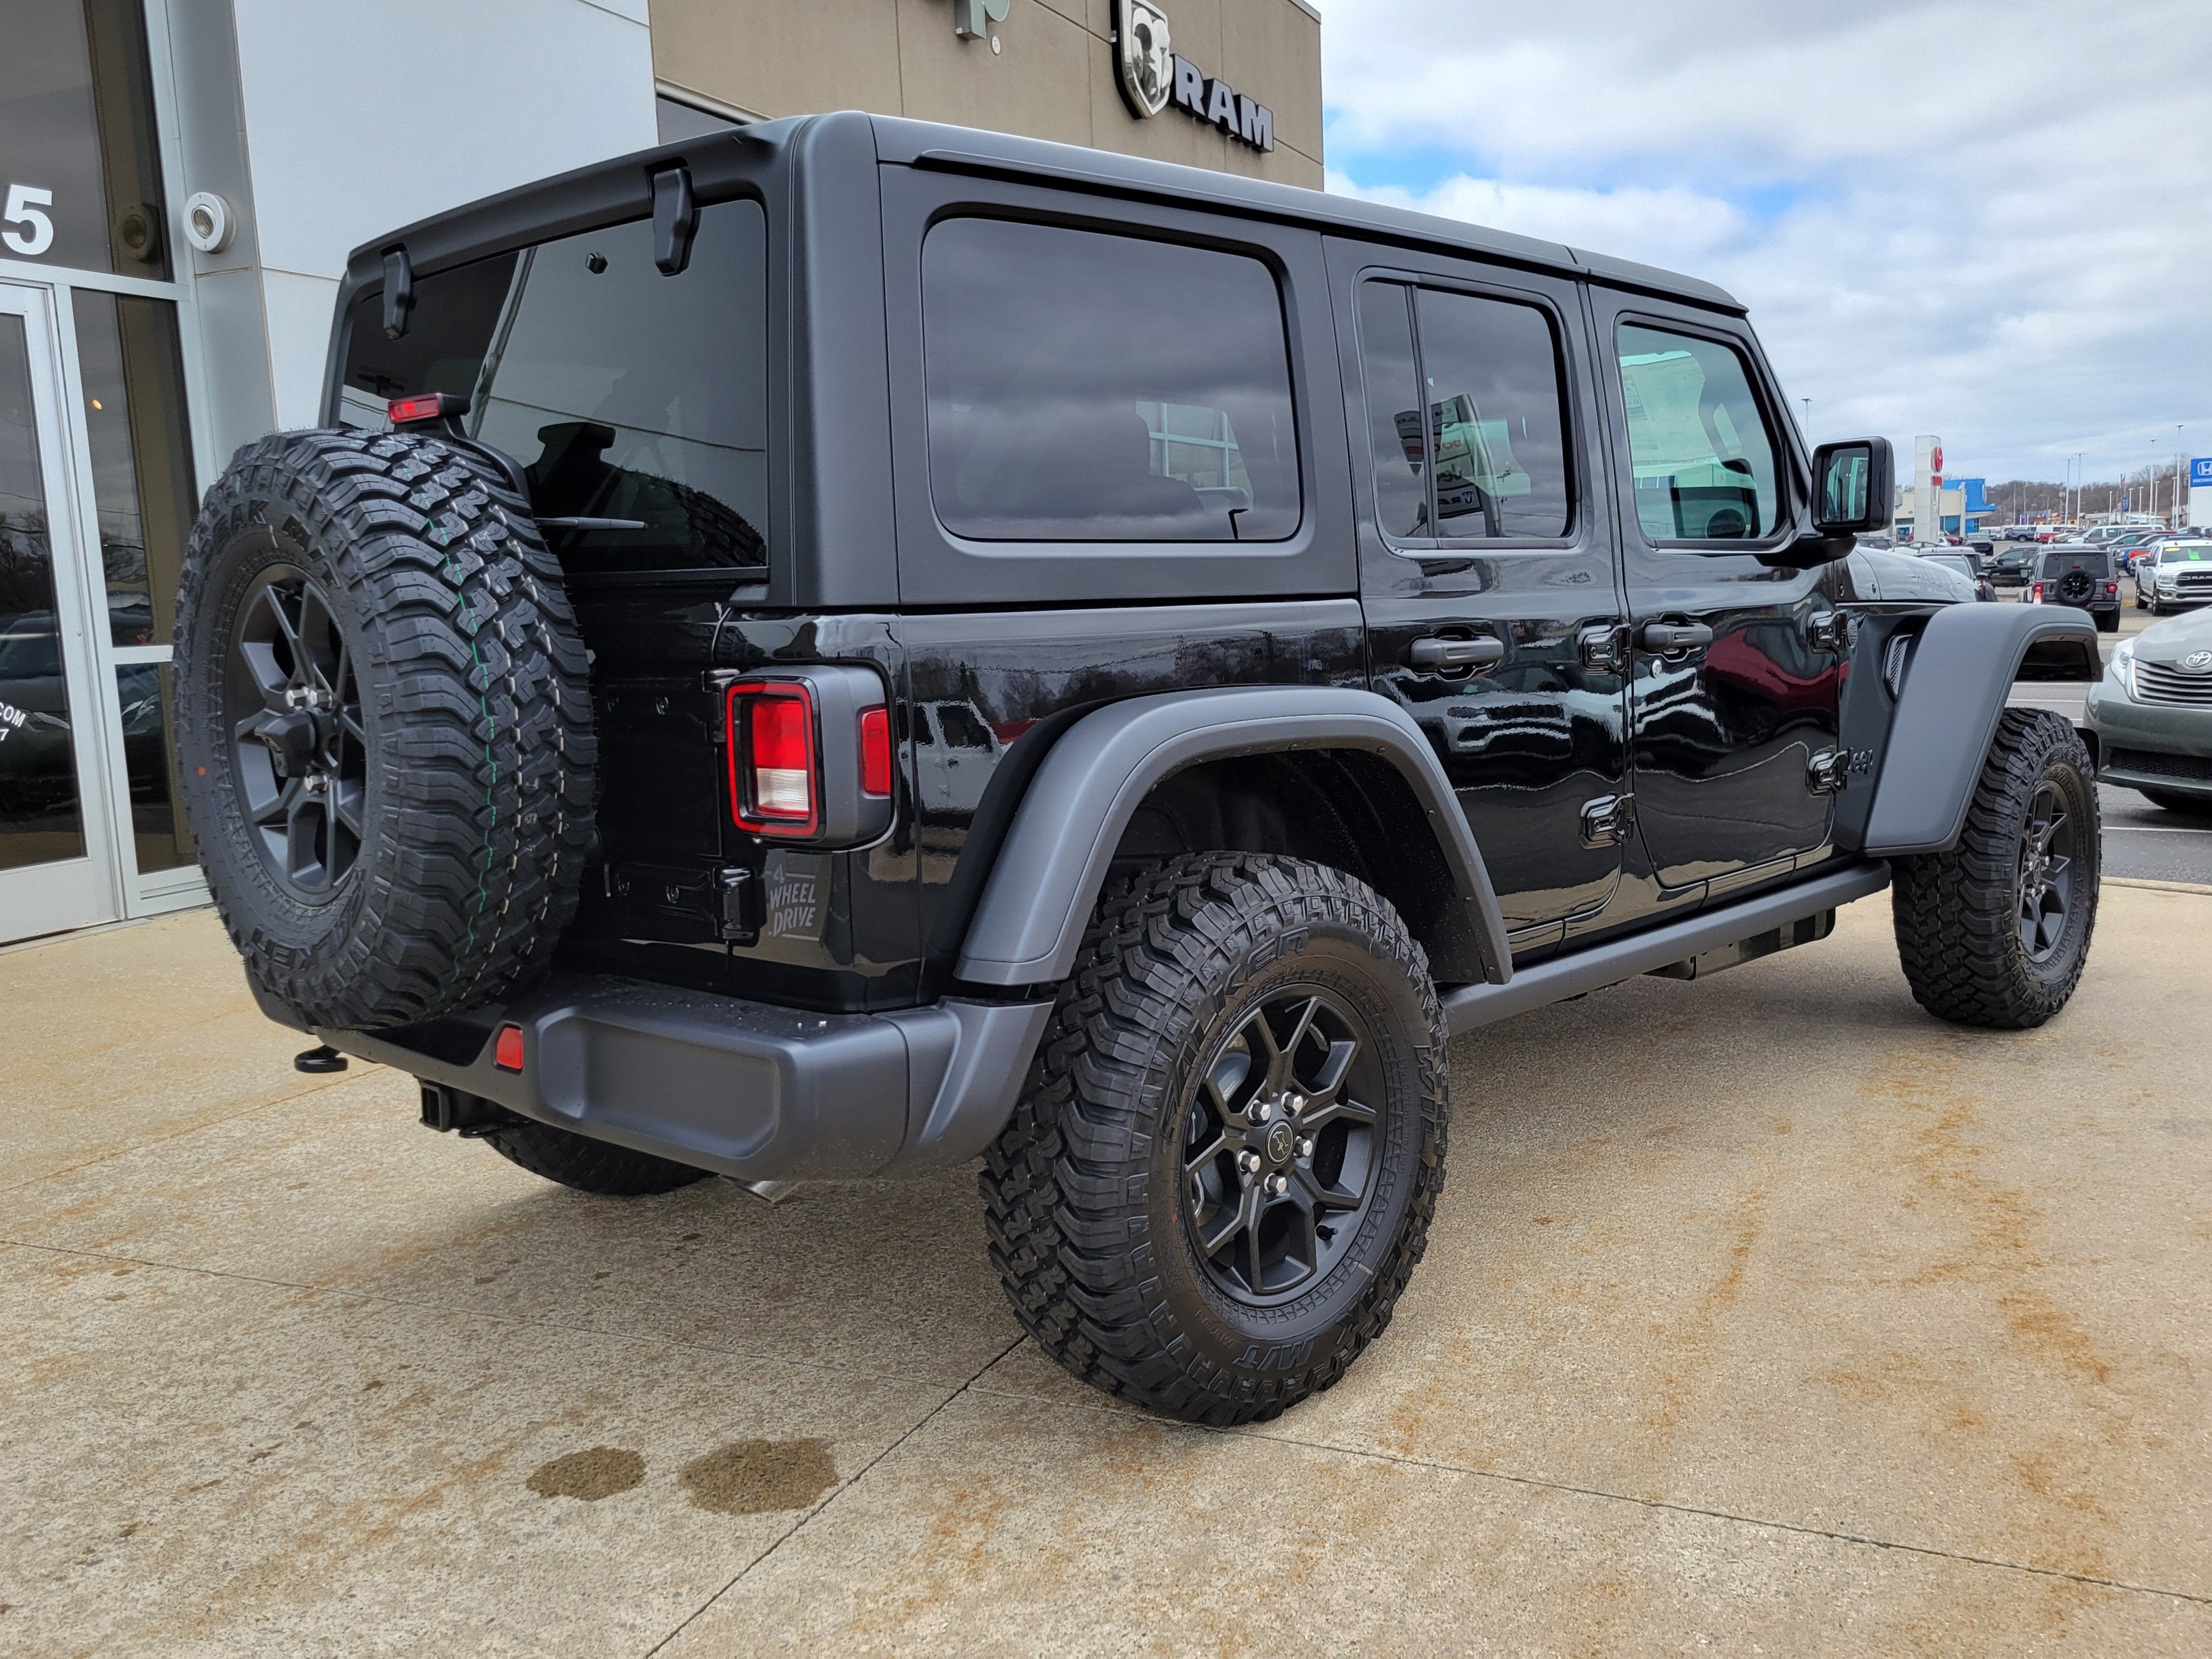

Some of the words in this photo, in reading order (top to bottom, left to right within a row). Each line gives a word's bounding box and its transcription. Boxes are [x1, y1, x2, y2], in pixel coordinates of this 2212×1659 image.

[1171, 53, 1274, 153] RAM
[2, 184, 54, 256] 5
[1847, 747, 1873, 775] Jeep
[772, 864, 786, 883] 4
[770, 883, 816, 909] WHEEL
[772, 907, 816, 937] DRIVE
[1335, 1046, 1436, 1345] WILDPEAK
[1232, 1333, 1317, 1370] M/T
